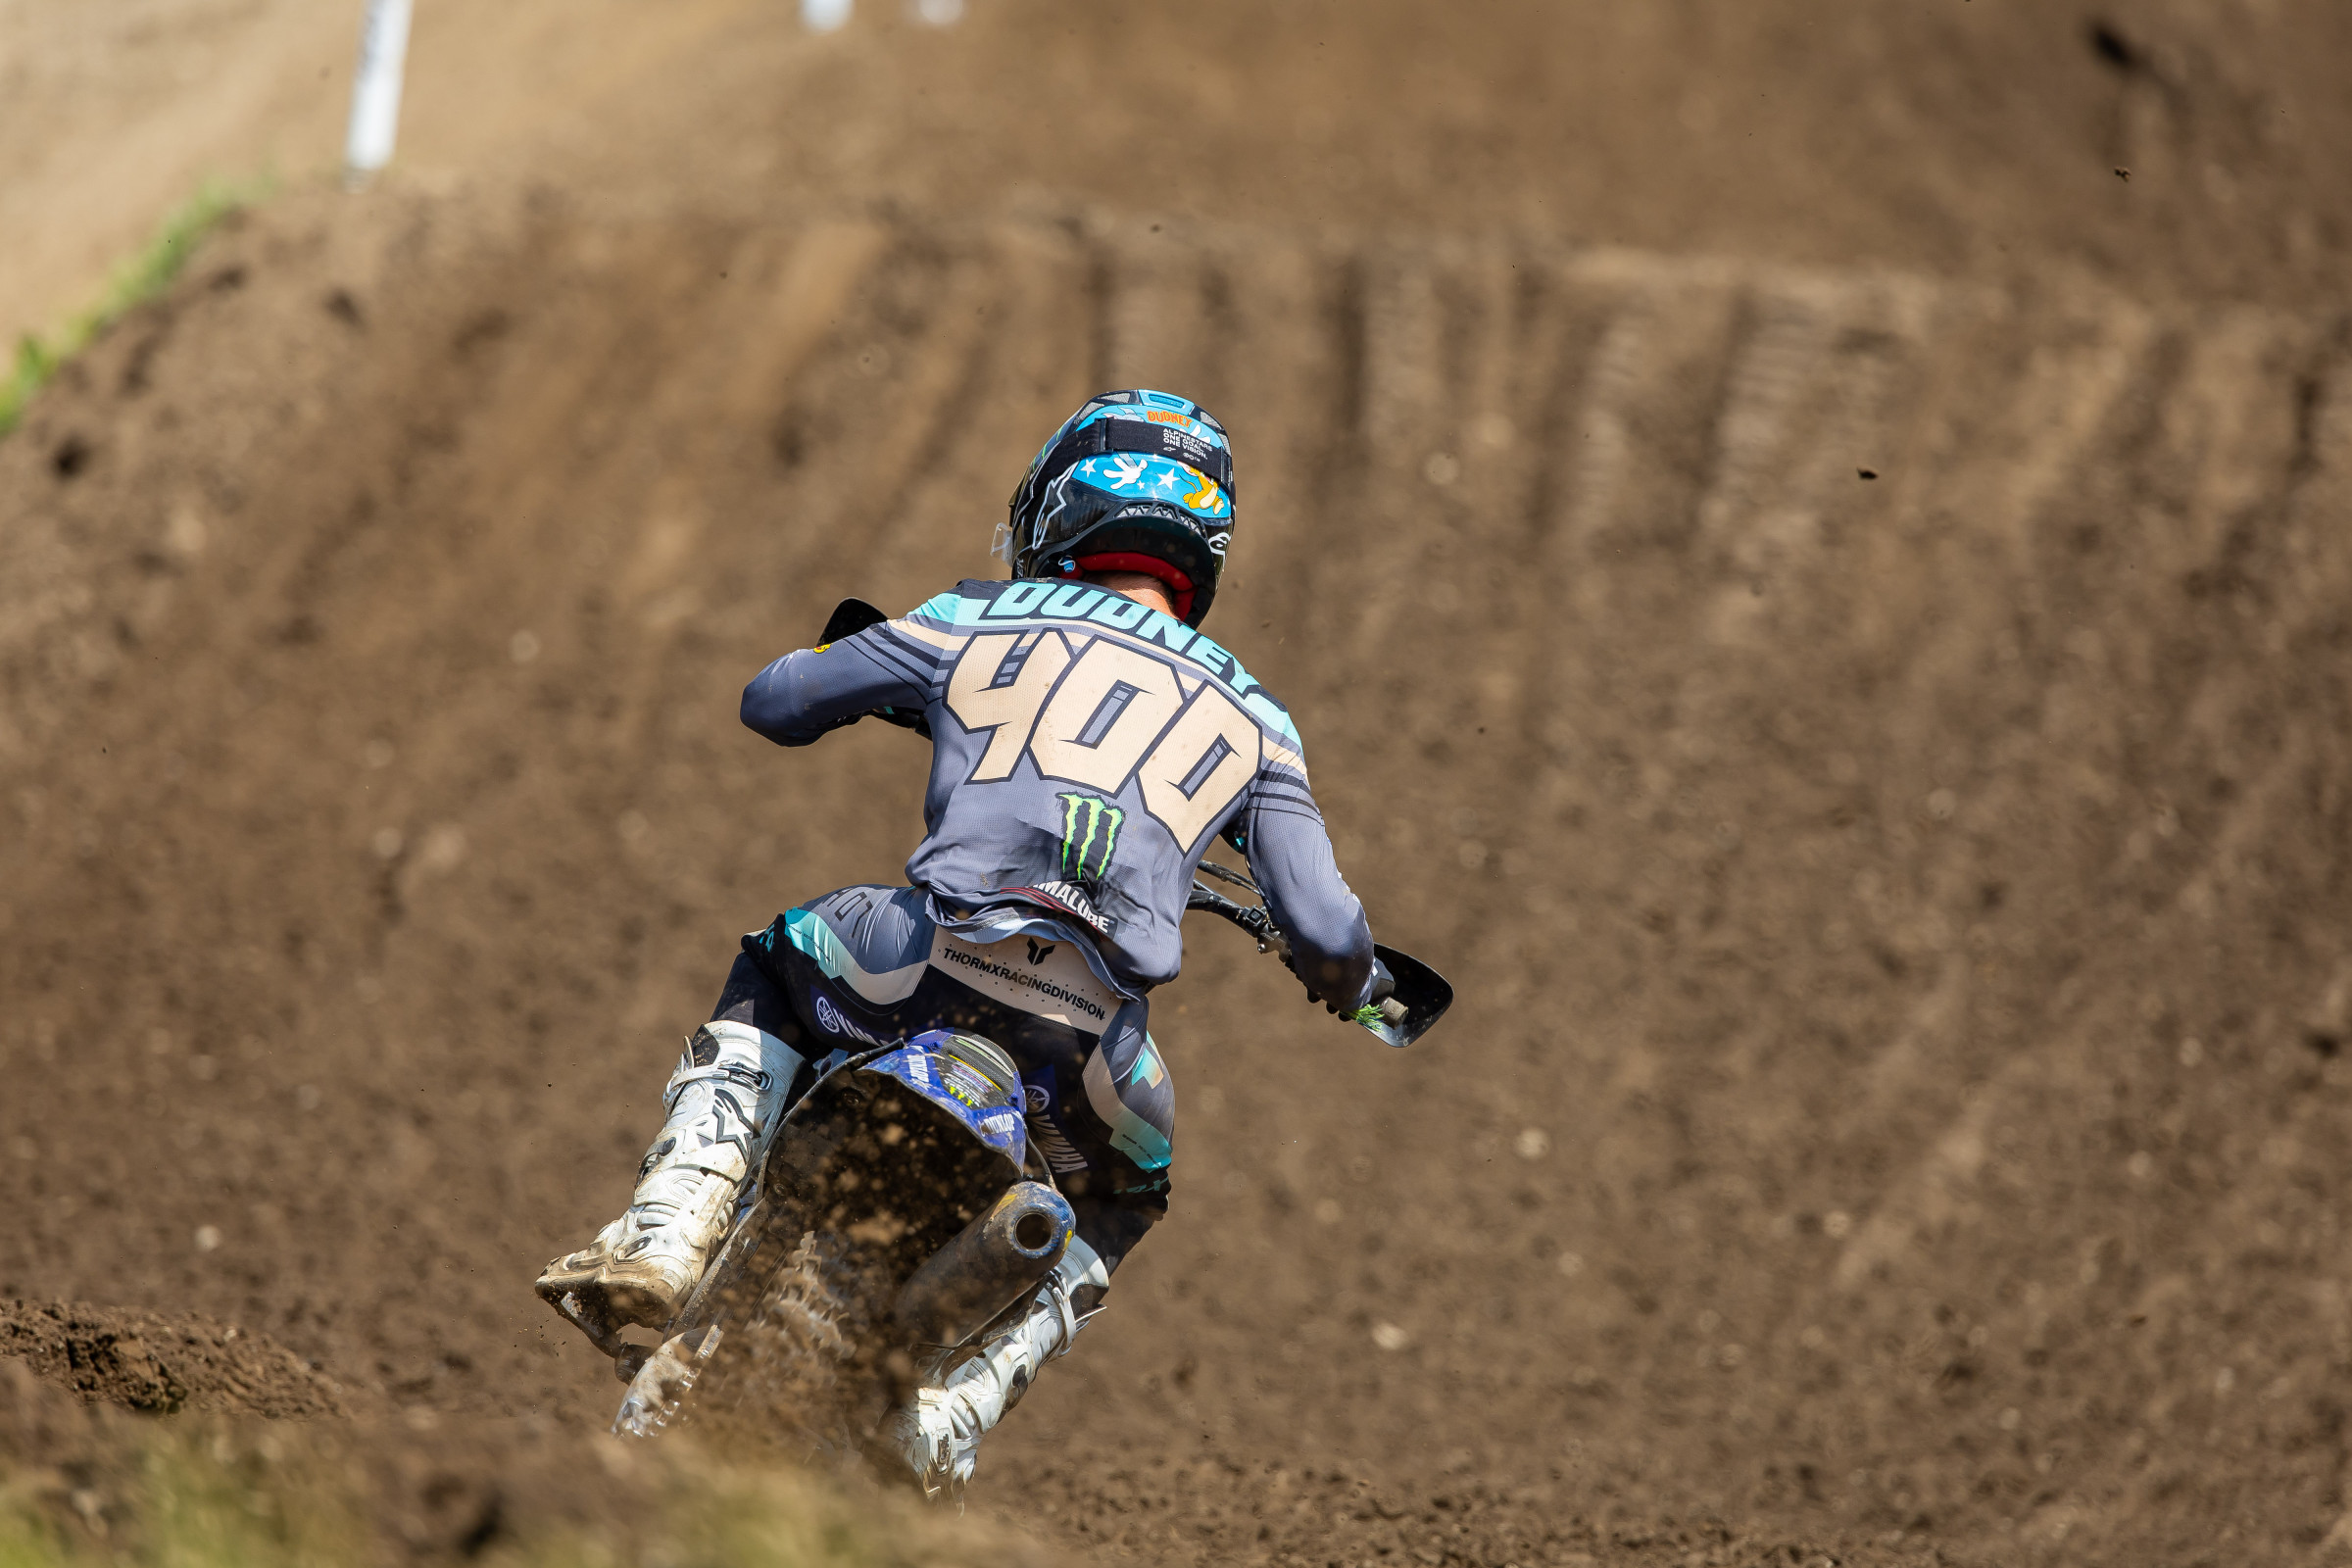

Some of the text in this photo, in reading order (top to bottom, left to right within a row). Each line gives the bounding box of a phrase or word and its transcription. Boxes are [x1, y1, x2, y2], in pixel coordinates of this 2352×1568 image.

[1147, 410, 1193, 428] DUDNEY
[1163, 432, 1181, 443] ONE
[1163, 428, 1212, 452] ALPINESTARS
[1163, 438, 1181, 448] ONE
[986, 581, 1261, 696] DUDNEY
[942, 626, 1263, 858] 400
